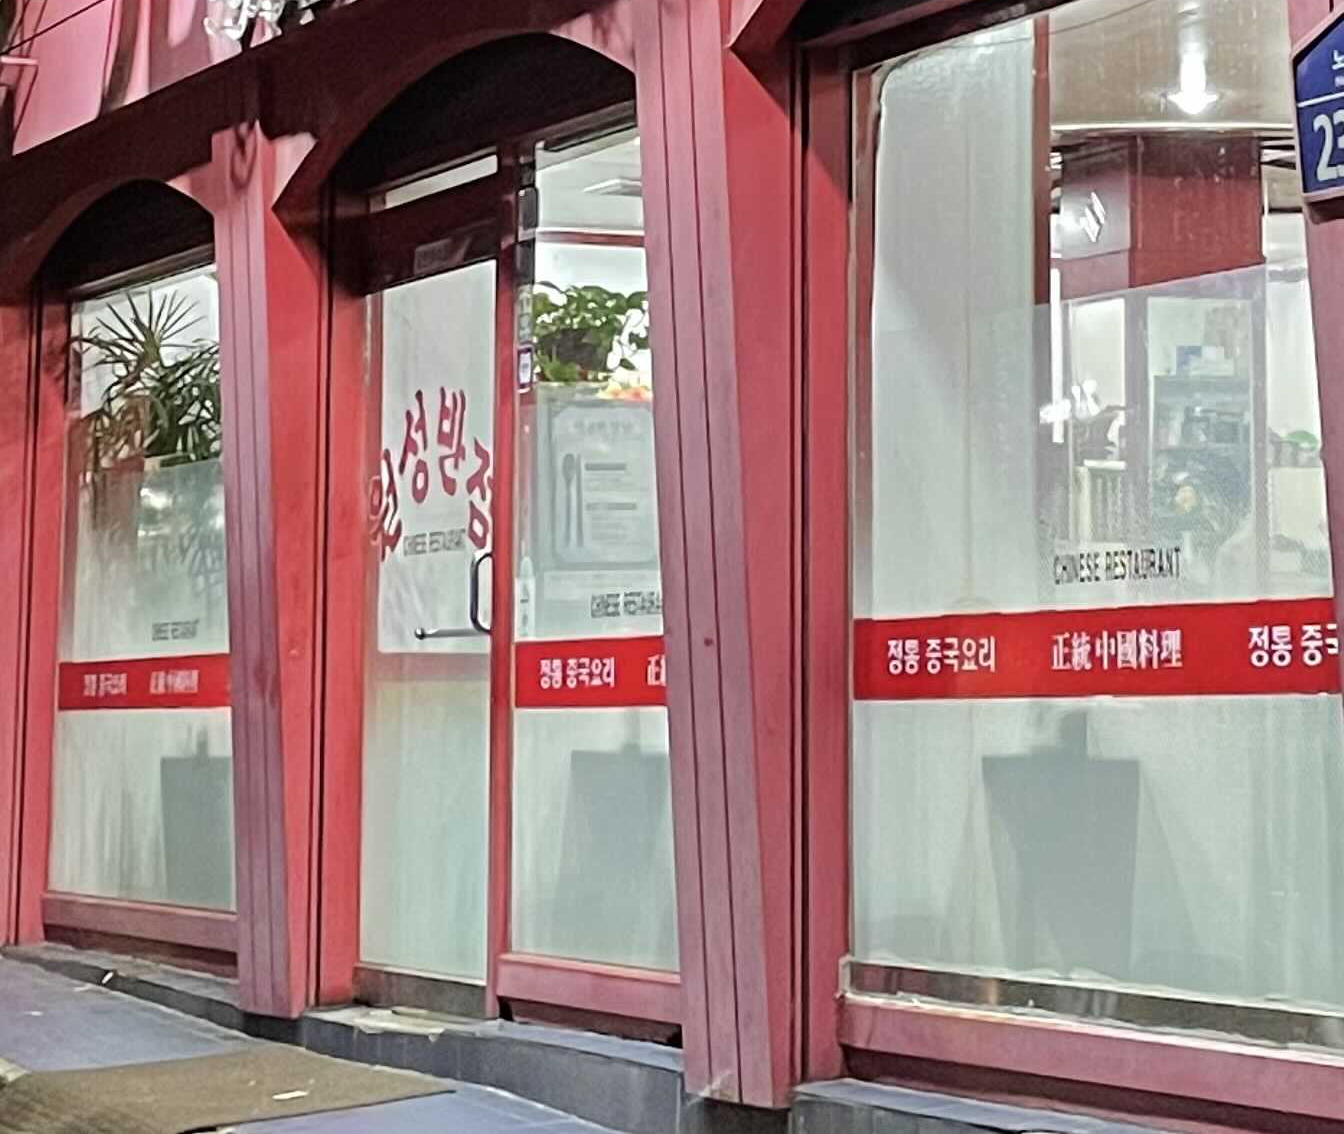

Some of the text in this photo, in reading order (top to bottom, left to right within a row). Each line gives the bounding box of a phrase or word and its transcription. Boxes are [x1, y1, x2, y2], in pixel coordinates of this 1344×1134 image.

[887, 635, 996, 675] 정통 중국요리
[1248, 625, 1292, 667] 정통
